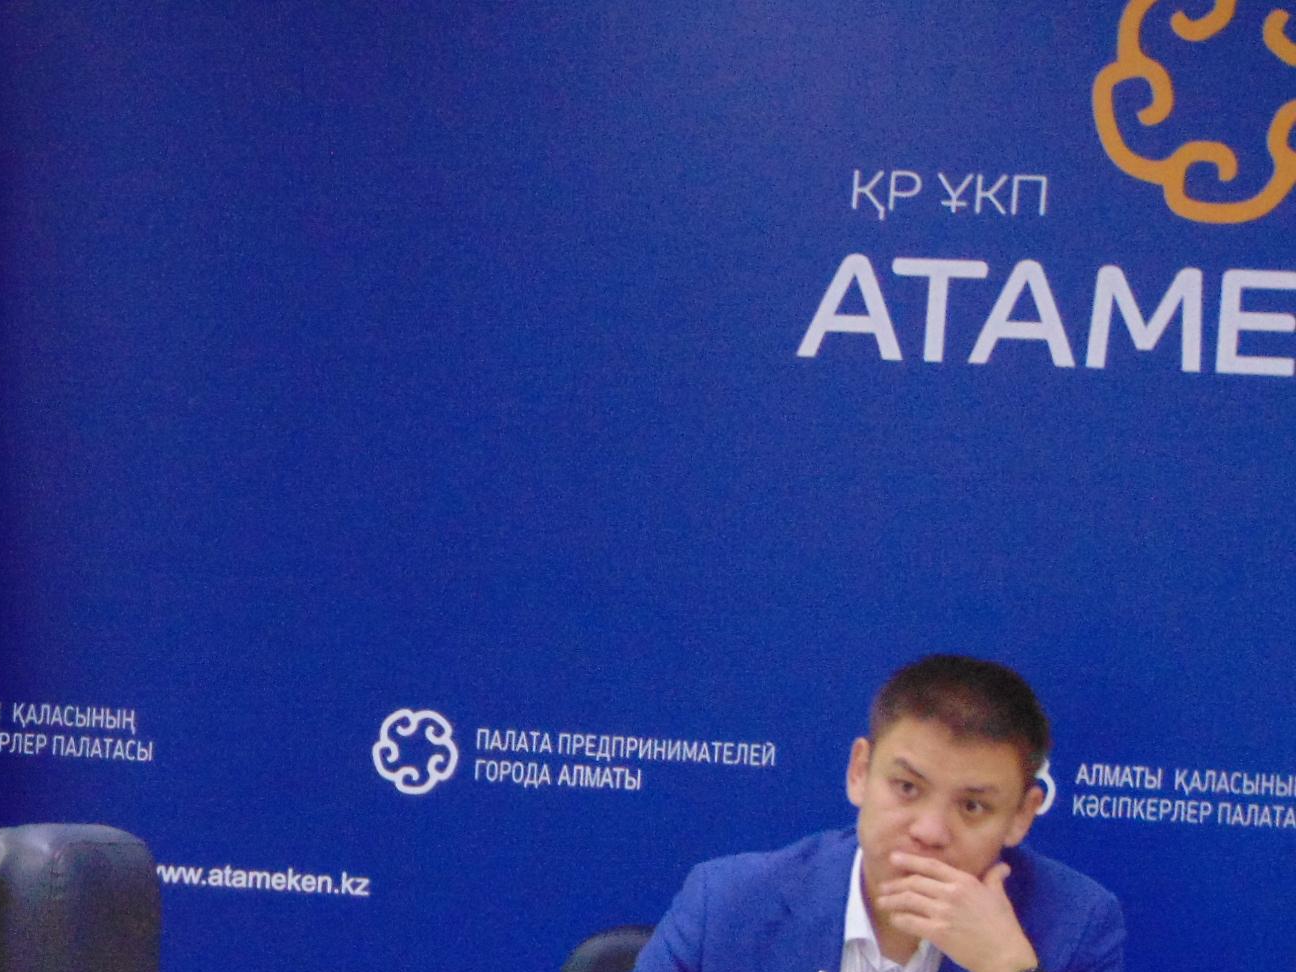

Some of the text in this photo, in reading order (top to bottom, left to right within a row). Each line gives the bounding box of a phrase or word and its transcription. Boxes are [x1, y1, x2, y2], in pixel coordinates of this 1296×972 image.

[851, 169, 923, 221] ҚР
[796, 252, 1296, 377] АТАМЕ
[12, 701, 136, 735] ҚАЛАСЫНЫҢ
[52, 735, 153, 762] ПАЛАТАСЫ
[475, 728, 776, 766] ПАЛАТА ПРЕДПРИНИМАТЕЛЕЙ
[474, 759, 642, 790] ГОРОДА АЛМАТЫ
[1075, 763, 1296, 797] АЛМАТЫ ҚАЛАСЫНЫ
[1072, 794, 1296, 828] КӘСІПКЕРЛЕР ПАЛАТА
[156, 864, 370, 896] ww.atameken.kz
